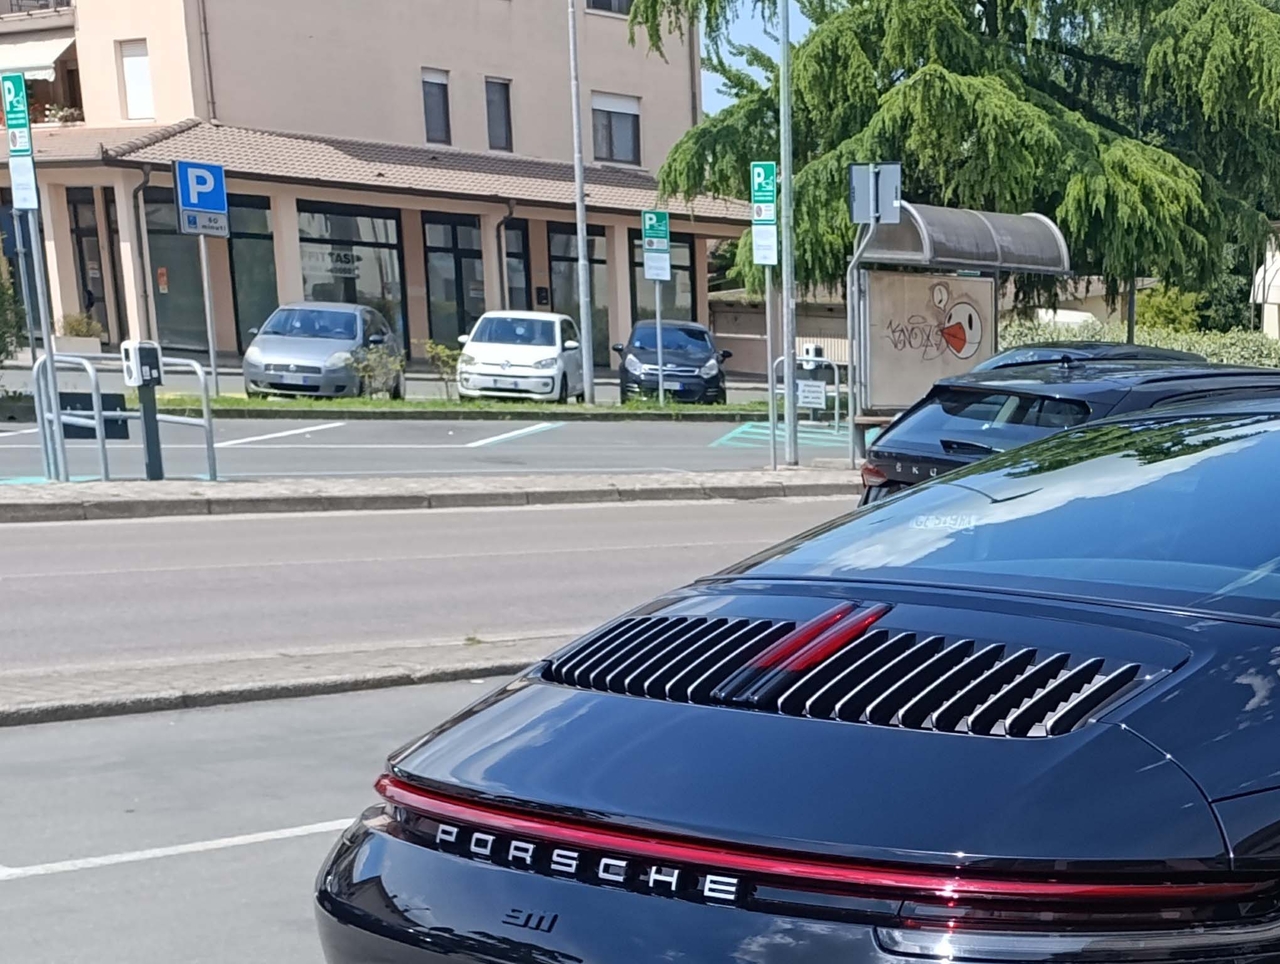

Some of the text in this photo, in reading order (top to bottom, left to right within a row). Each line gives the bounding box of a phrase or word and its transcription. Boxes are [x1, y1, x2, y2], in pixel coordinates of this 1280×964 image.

[187, 168, 214, 204] P
[753, 167, 765, 191] P
[645, 213, 657, 230] P
[435, 823, 740, 900] PORSCHE
